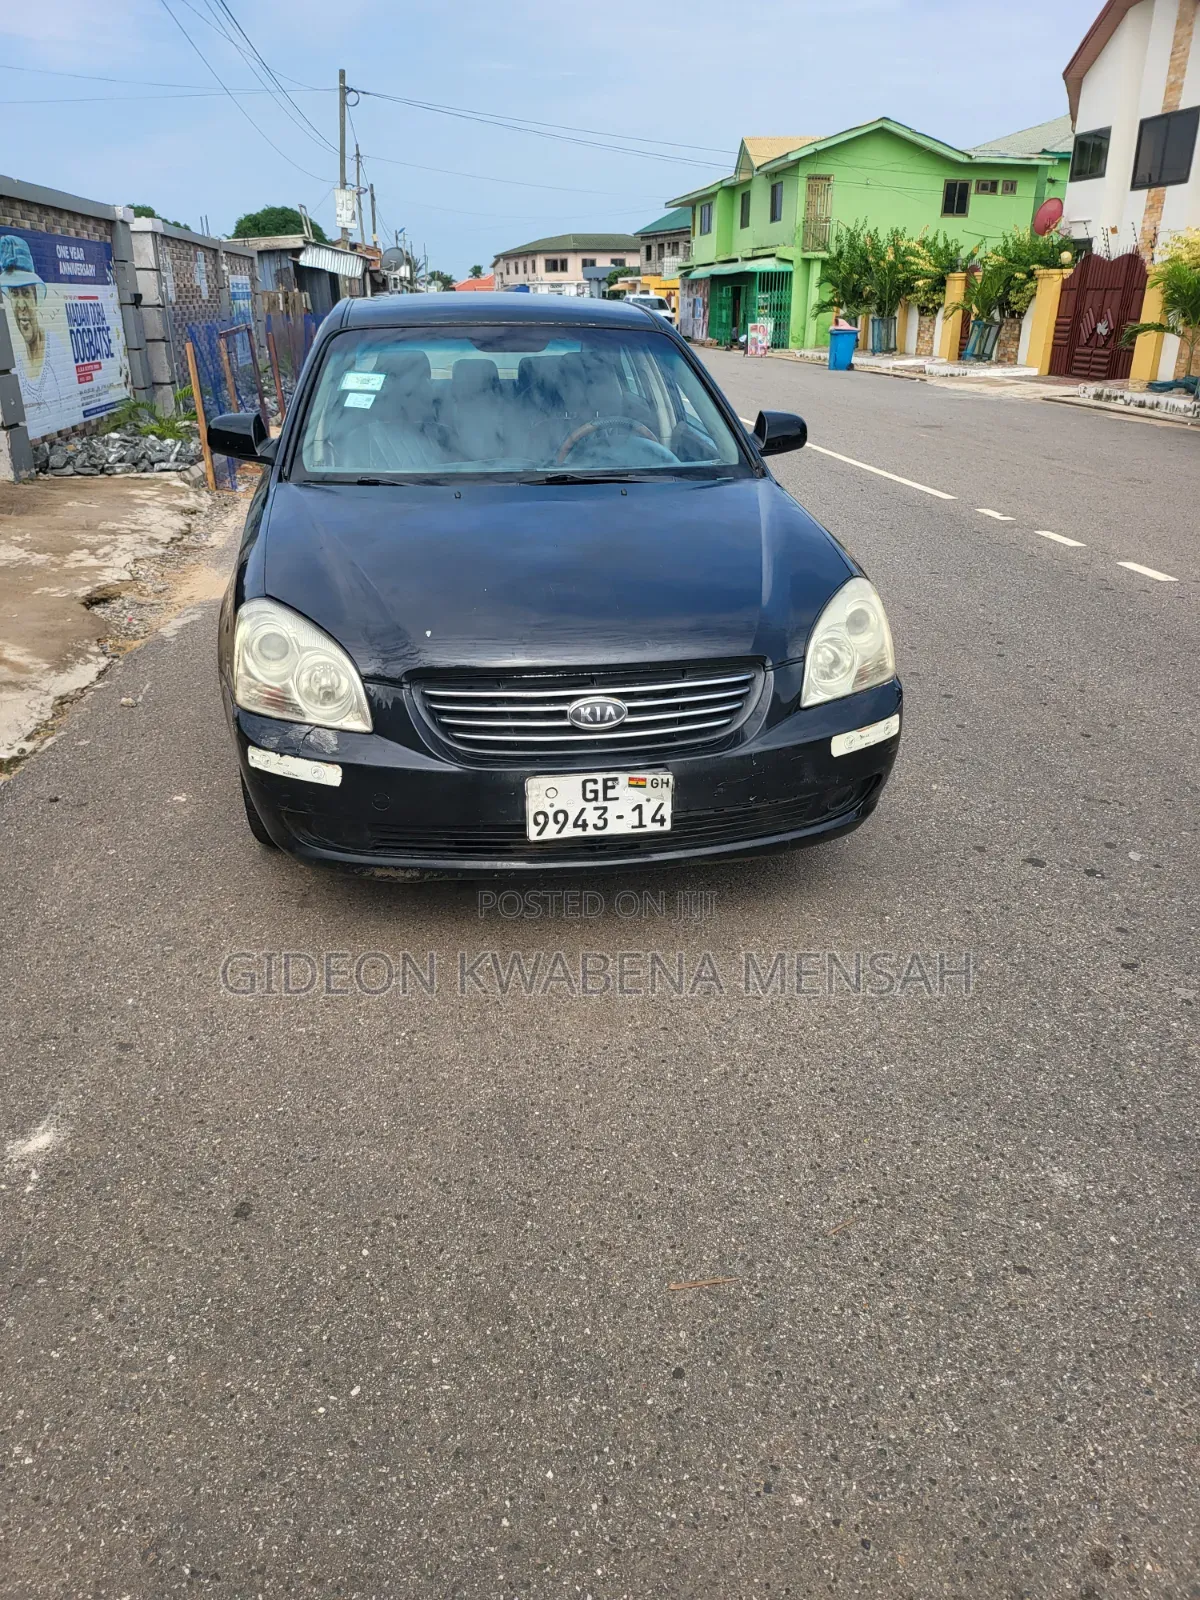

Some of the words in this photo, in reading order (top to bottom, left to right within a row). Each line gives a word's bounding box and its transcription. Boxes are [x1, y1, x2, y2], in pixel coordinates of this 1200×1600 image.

[56, 244, 69, 259] ONE
[69, 246, 85, 261] YEAR
[59, 260, 96, 277] ANNIVERSARY
[65, 302, 91, 327] MADAM
[89, 302, 107, 326] DORA
[69, 325, 115, 364] DOGBATSE
[579, 706, 617, 723] KIA
[581, 777, 620, 802] GE
[650, 777, 670, 789] GH
[532, 802, 667, 837] 9943-14
